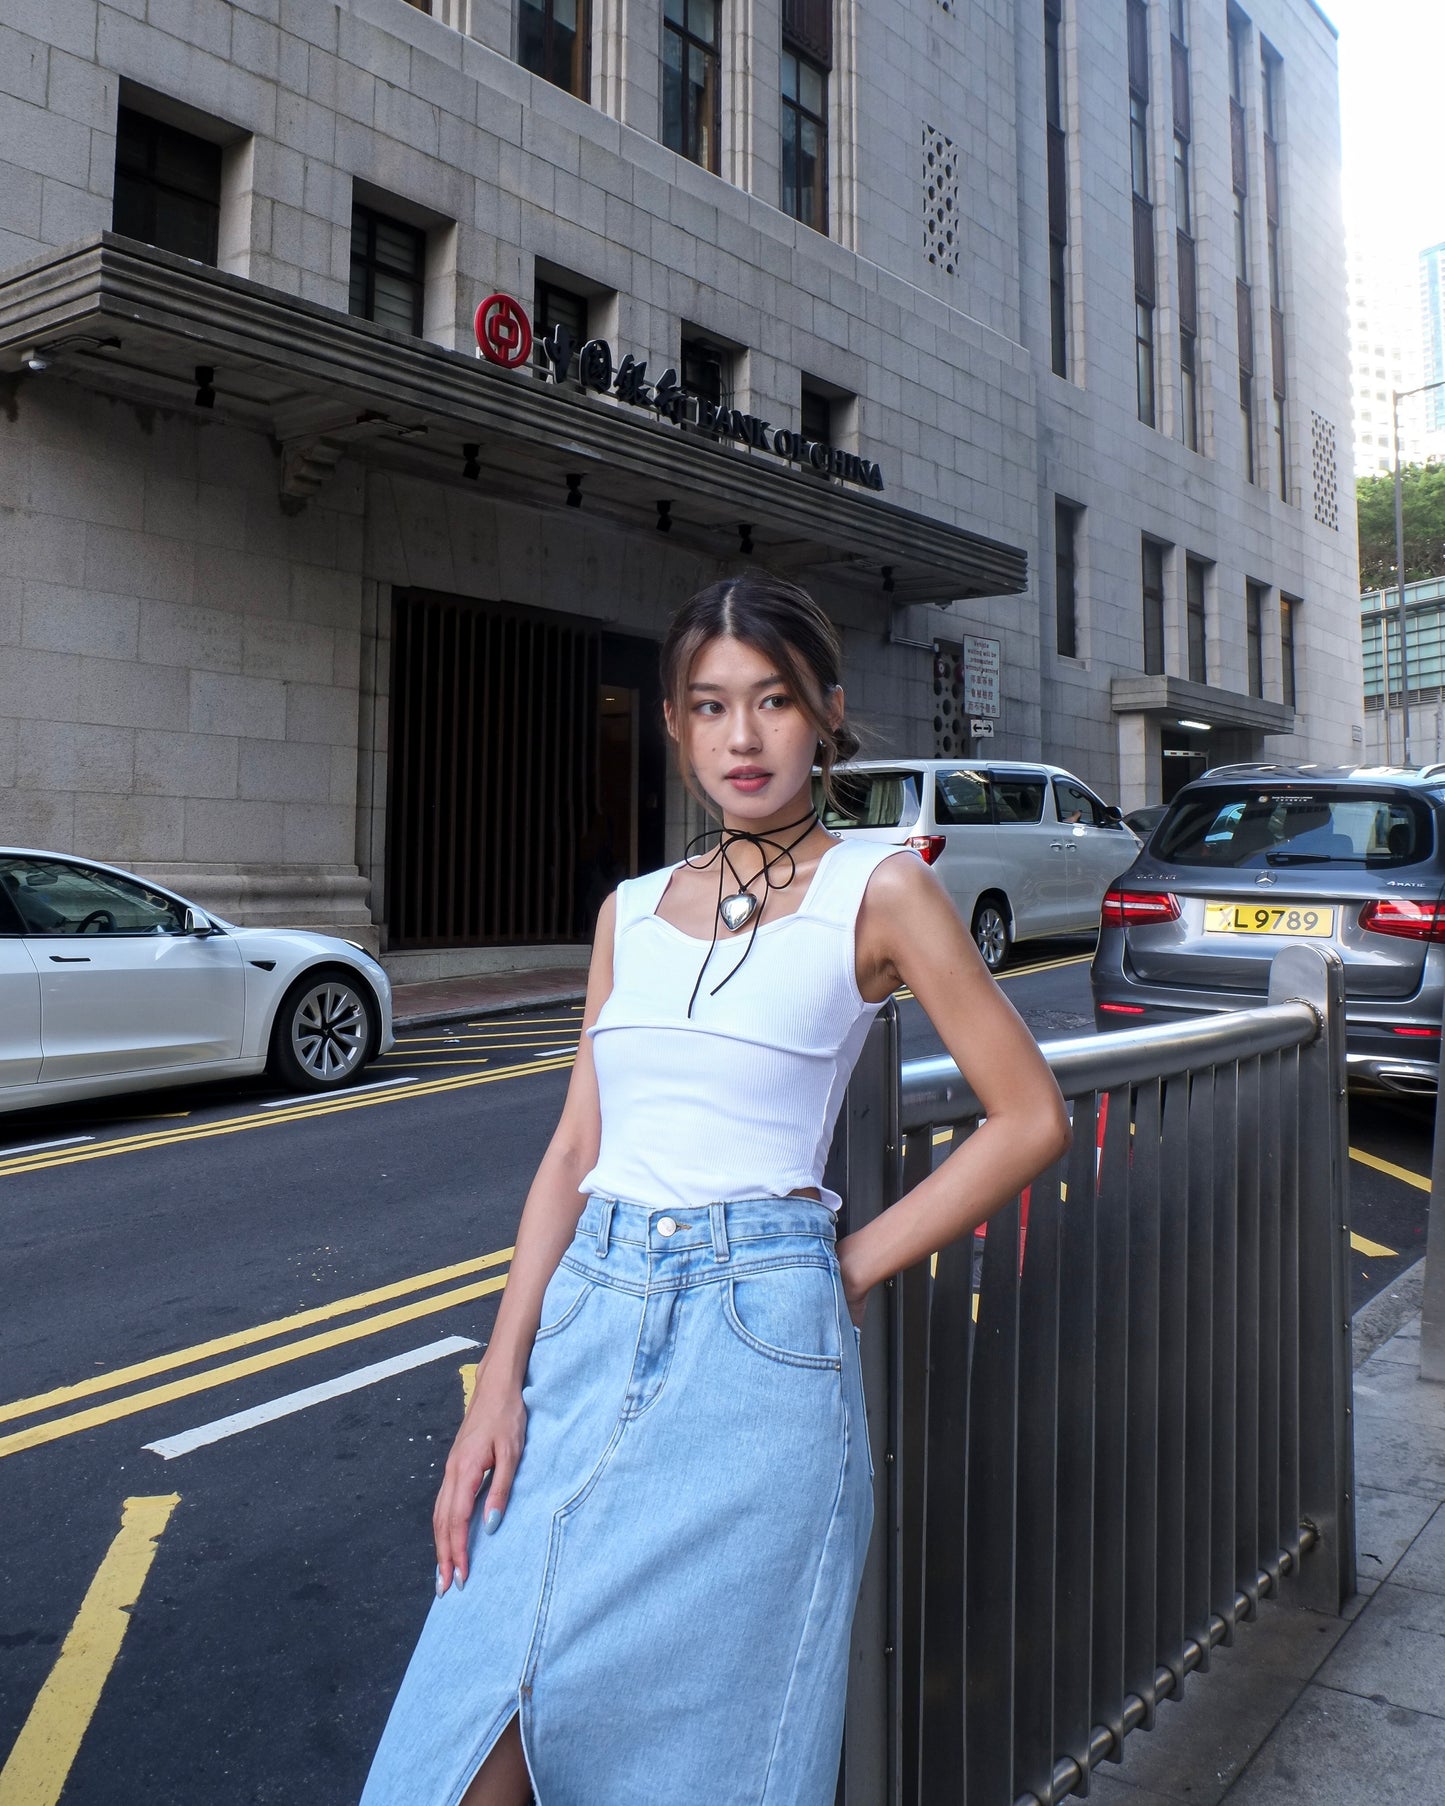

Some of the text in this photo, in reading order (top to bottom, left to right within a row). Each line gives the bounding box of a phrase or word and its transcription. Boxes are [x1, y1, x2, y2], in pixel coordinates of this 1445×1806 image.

[695, 397, 885, 492] BANK OF CHINA
[1254, 909, 1319, 931] 9789
